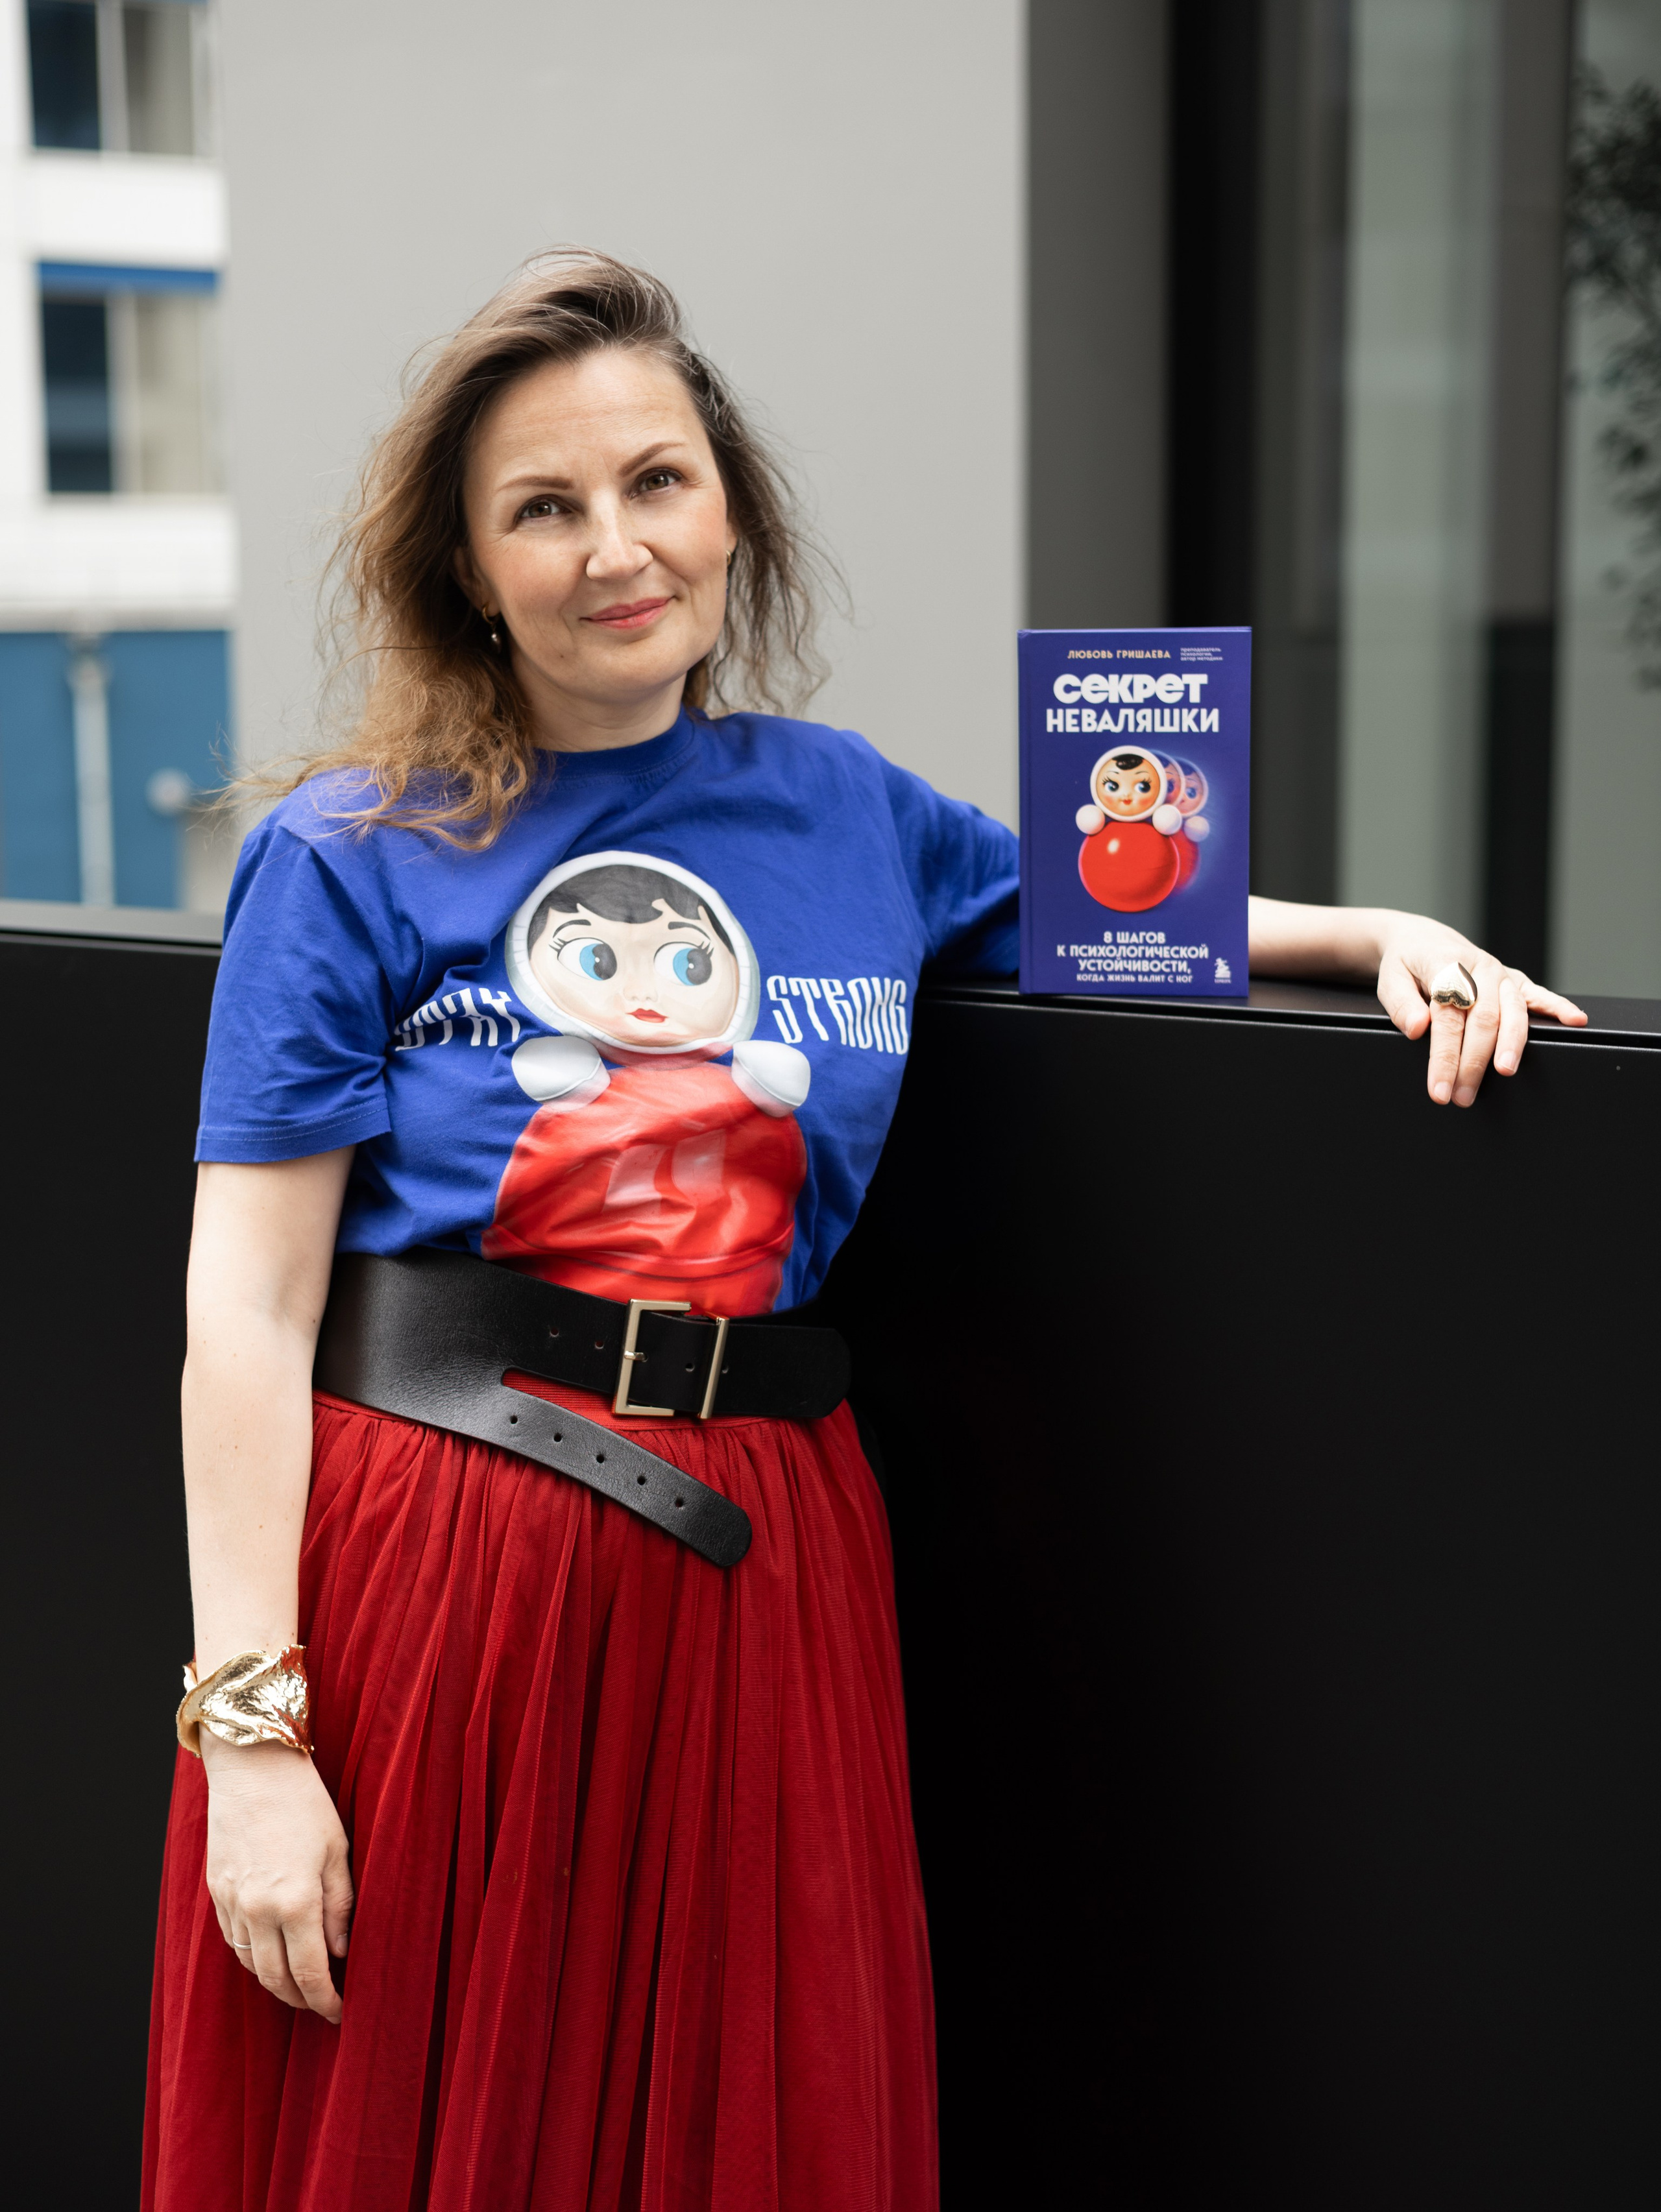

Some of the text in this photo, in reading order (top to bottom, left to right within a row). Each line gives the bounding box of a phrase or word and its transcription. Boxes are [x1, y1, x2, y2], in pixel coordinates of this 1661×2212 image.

[1067, 650, 1171, 659] ЛЮБОВЬ ГРИШАЕВА
[1047, 708, 1219, 733] НЕВАЛЯШКИ
[1104, 931, 1166, 944] 8 ШАГОВ
[1057, 943, 1209, 959] К ПСИХОЛОГИЧЕСКОЙ
[1078, 957, 1192, 974] УСТОЙЧИВОСТИ,
[1076, 974, 1104, 982] КОГДА
[766, 975, 909, 1055] STRONG
